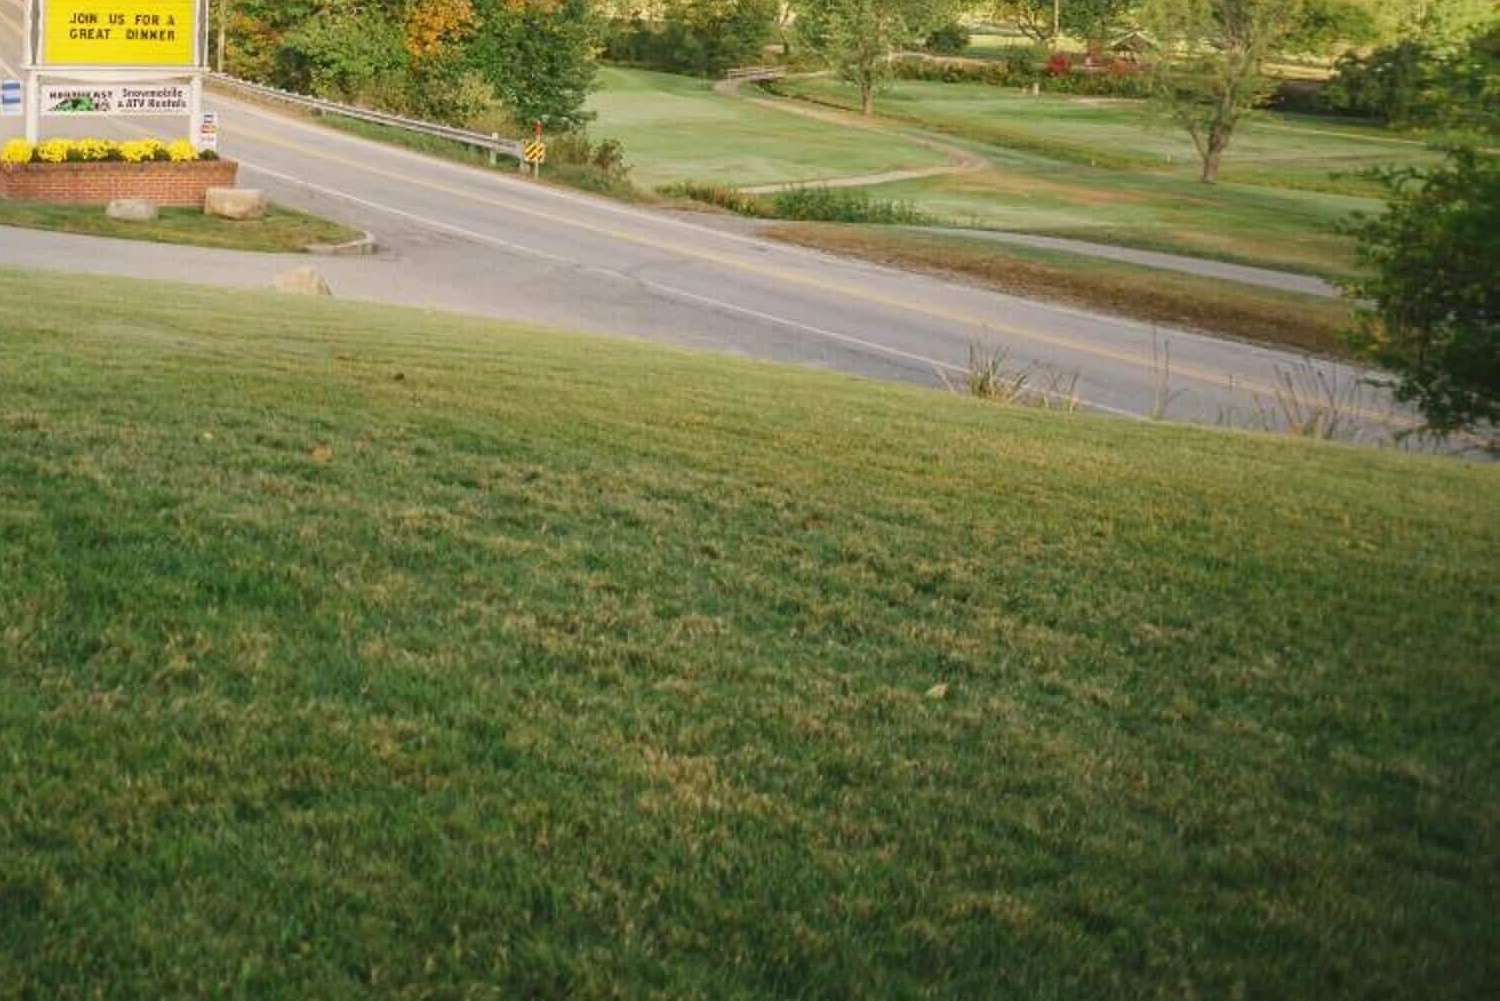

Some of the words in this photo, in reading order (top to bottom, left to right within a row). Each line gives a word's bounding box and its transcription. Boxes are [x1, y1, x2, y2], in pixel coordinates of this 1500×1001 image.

[69, 13, 98, 24] JOIN
[109, 13, 125, 25] US
[134, 14, 160, 25] FOR
[167, 14, 175, 25] A
[69, 29, 111, 40] GREAT
[126, 29, 175, 41] DINNER
[126, 99, 145, 108] ATV
